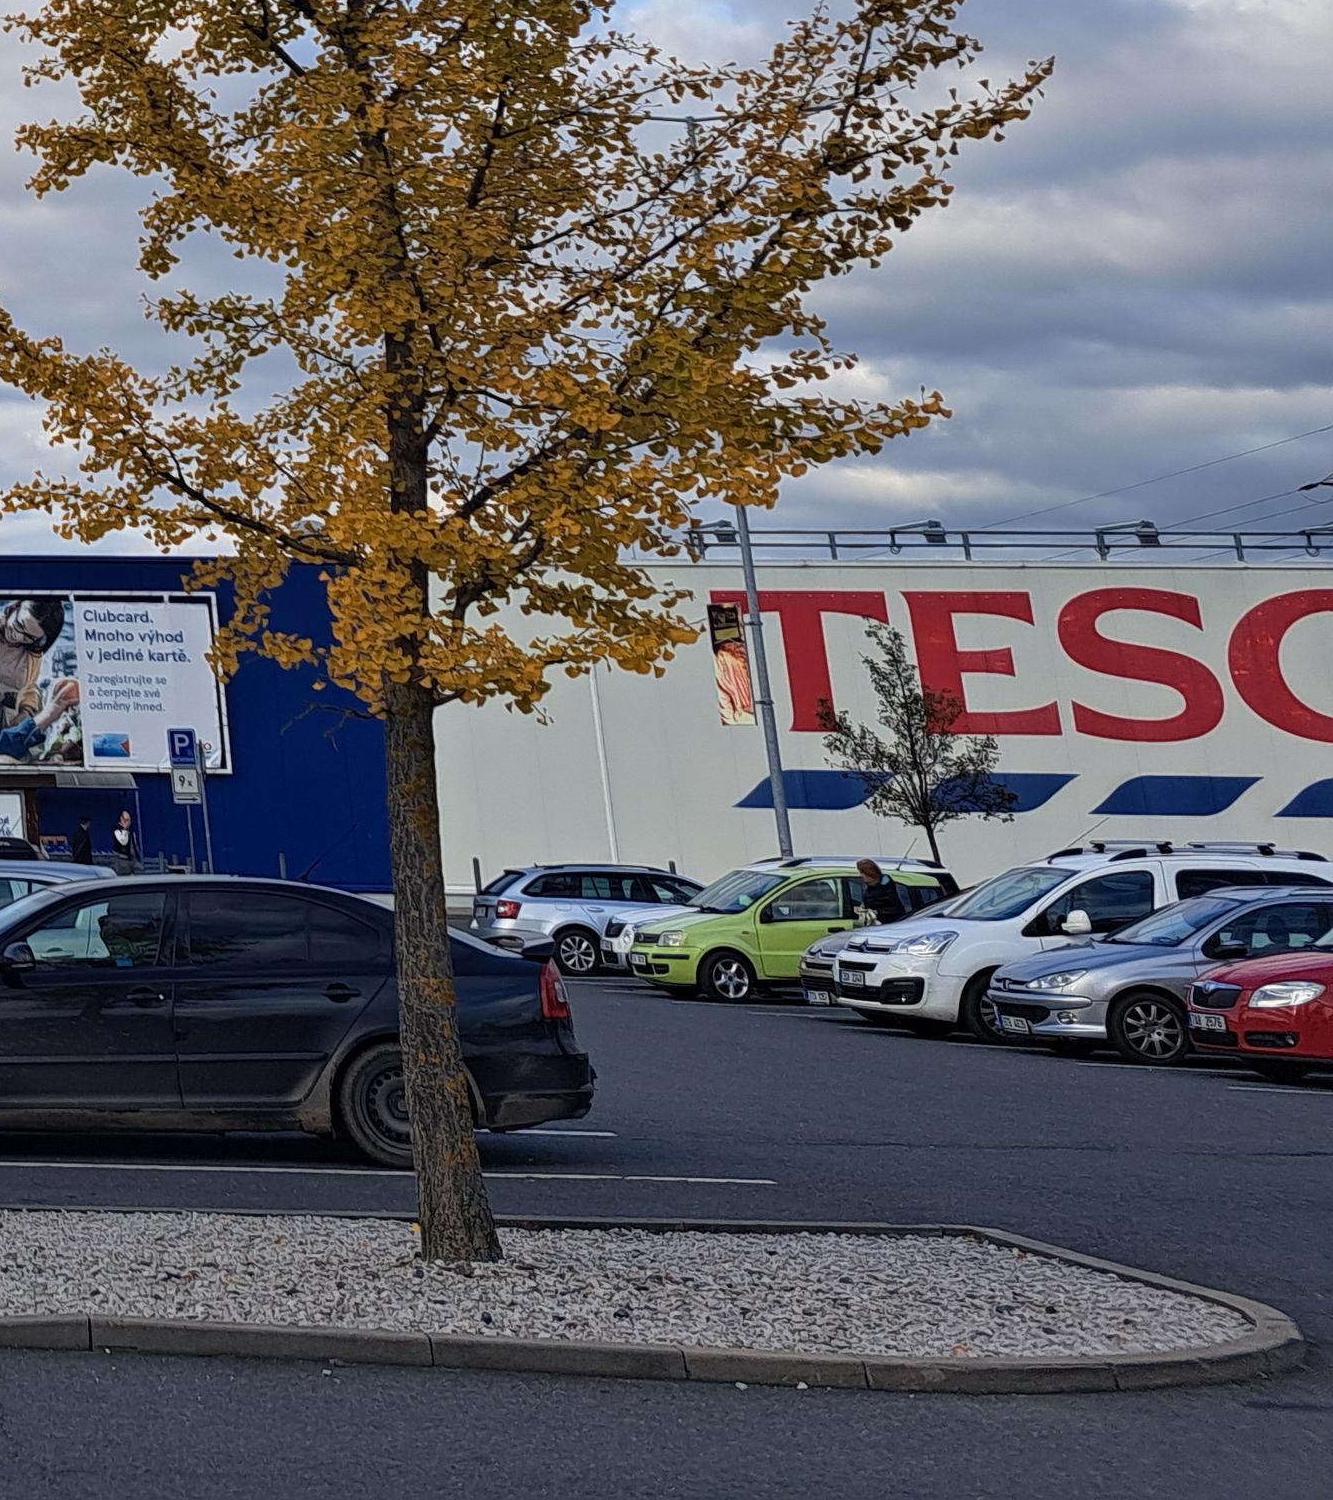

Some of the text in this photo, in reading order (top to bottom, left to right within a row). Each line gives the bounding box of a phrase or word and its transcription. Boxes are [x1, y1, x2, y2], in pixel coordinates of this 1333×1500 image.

[83, 610, 154, 624] Clubcard.
[85, 629, 184, 645] Mnoho výhod
[85, 648, 192, 664] v jediné kartě.
[87, 673, 152, 686] Zaregistrujte
[88, 687, 160, 700] a čerpejte své
[89, 702, 130, 713] odměny
[174, 733, 190, 755] P
